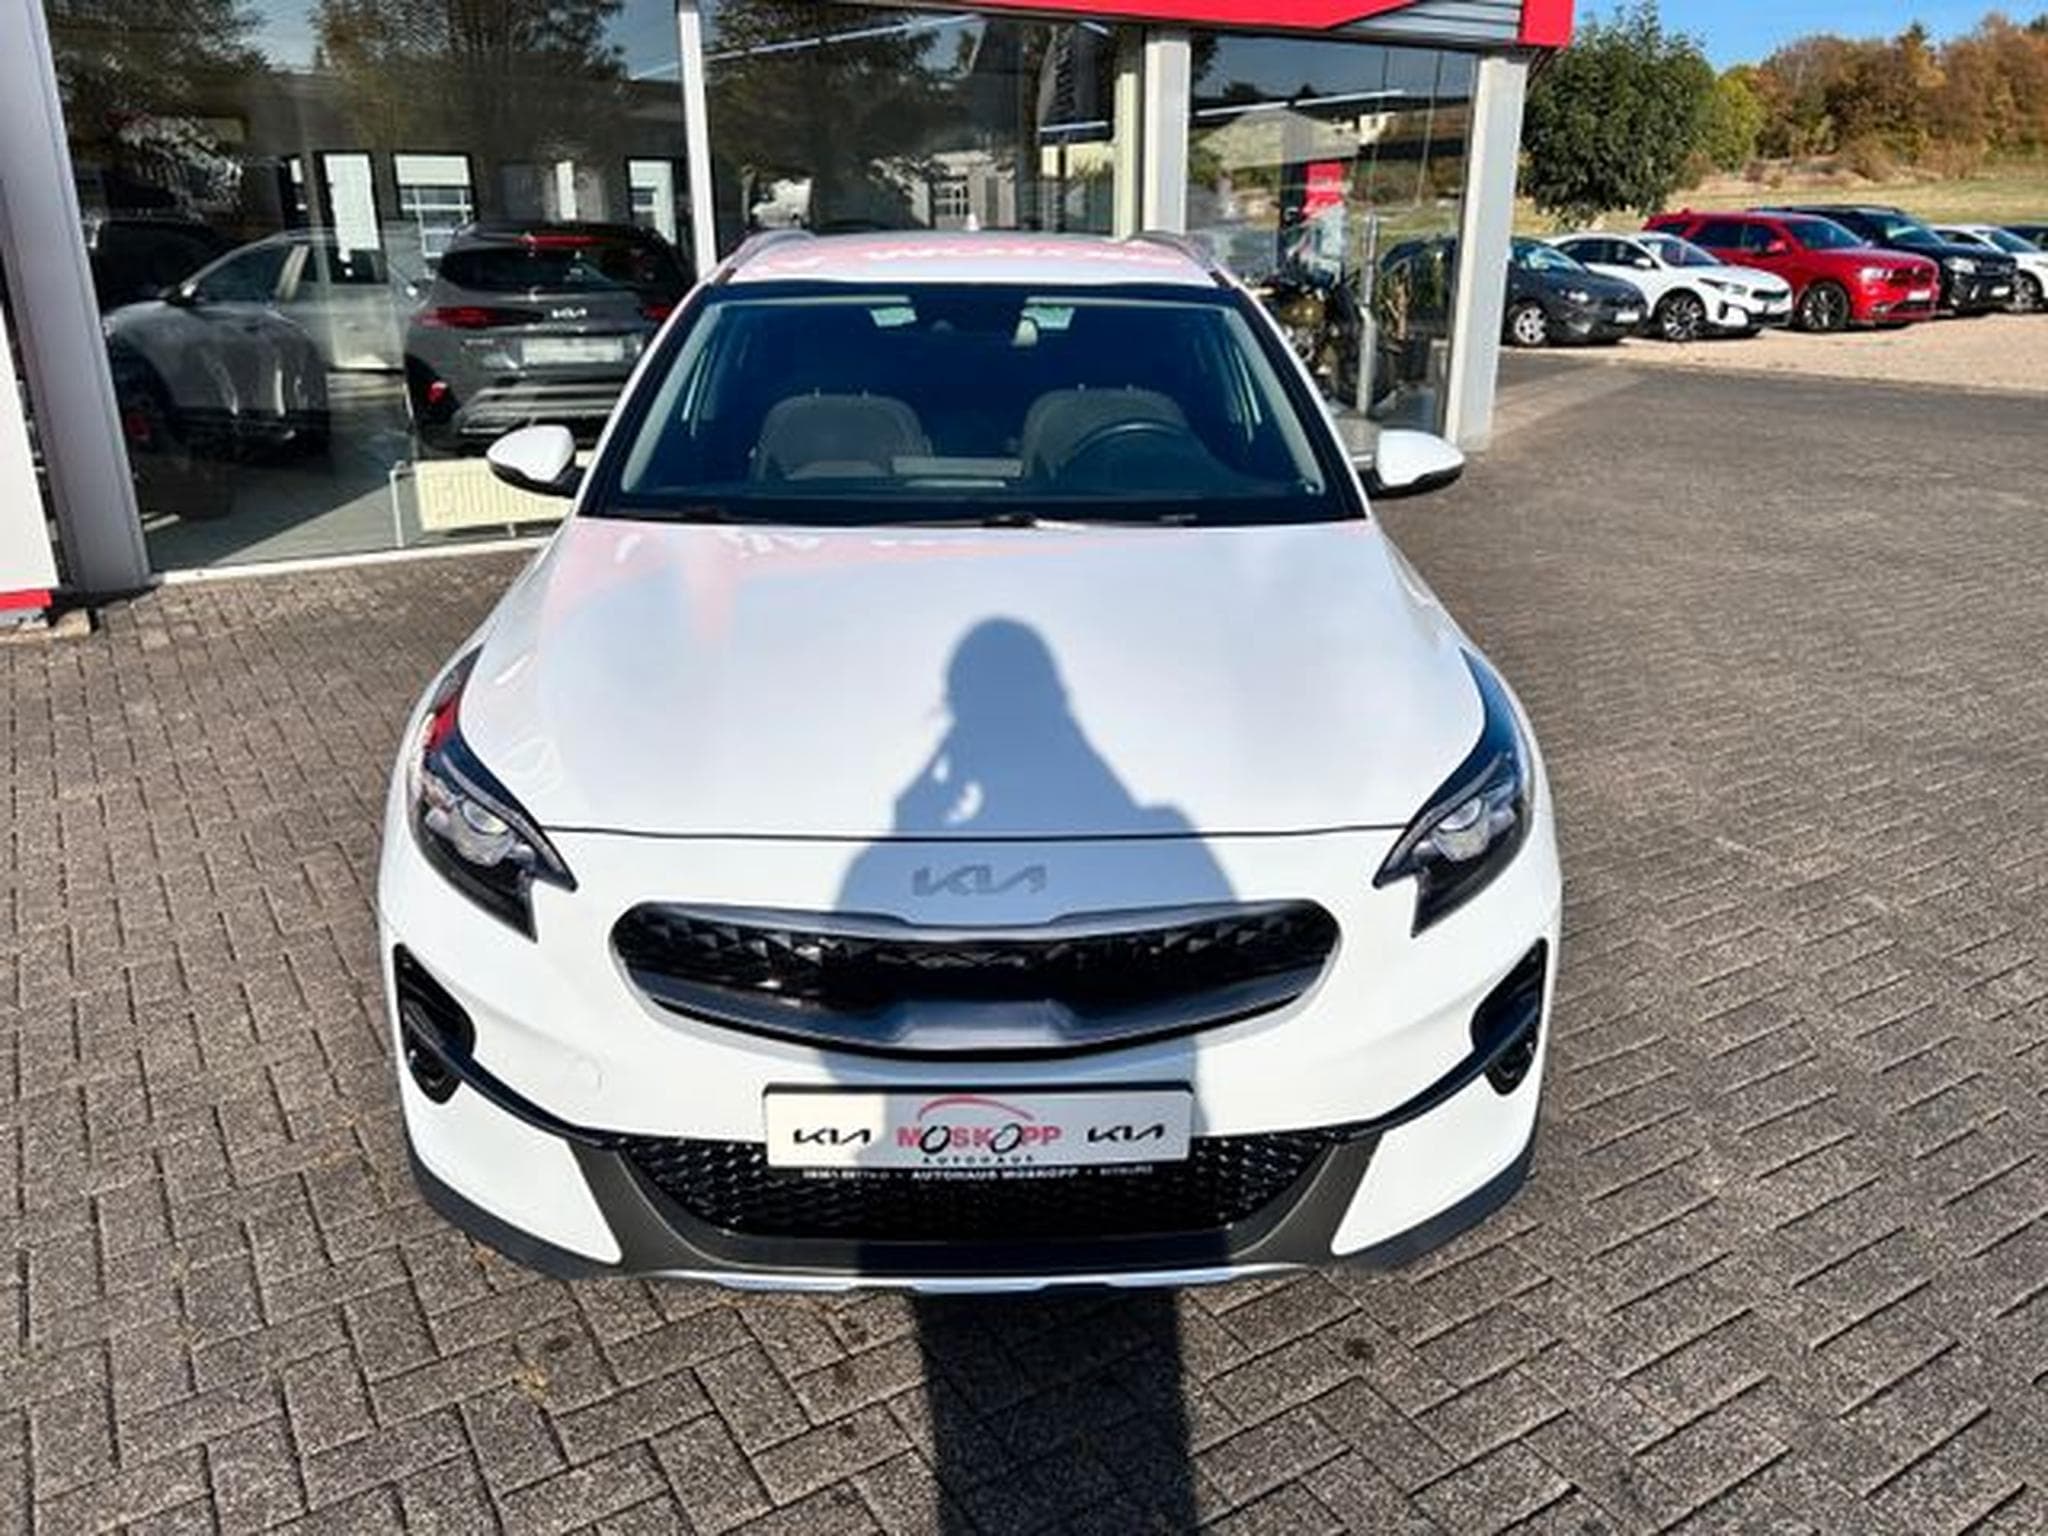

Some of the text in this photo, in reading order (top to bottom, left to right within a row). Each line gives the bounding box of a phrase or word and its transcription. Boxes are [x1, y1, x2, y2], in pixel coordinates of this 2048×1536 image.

[912, 864, 1047, 896] KIA
[794, 1126, 870, 1145] KIA
[896, 1122, 1062, 1154] MOSKOPP
[1088, 1123, 1164, 1144] KIA
[923, 1155, 1033, 1164] AUTOHAUS
